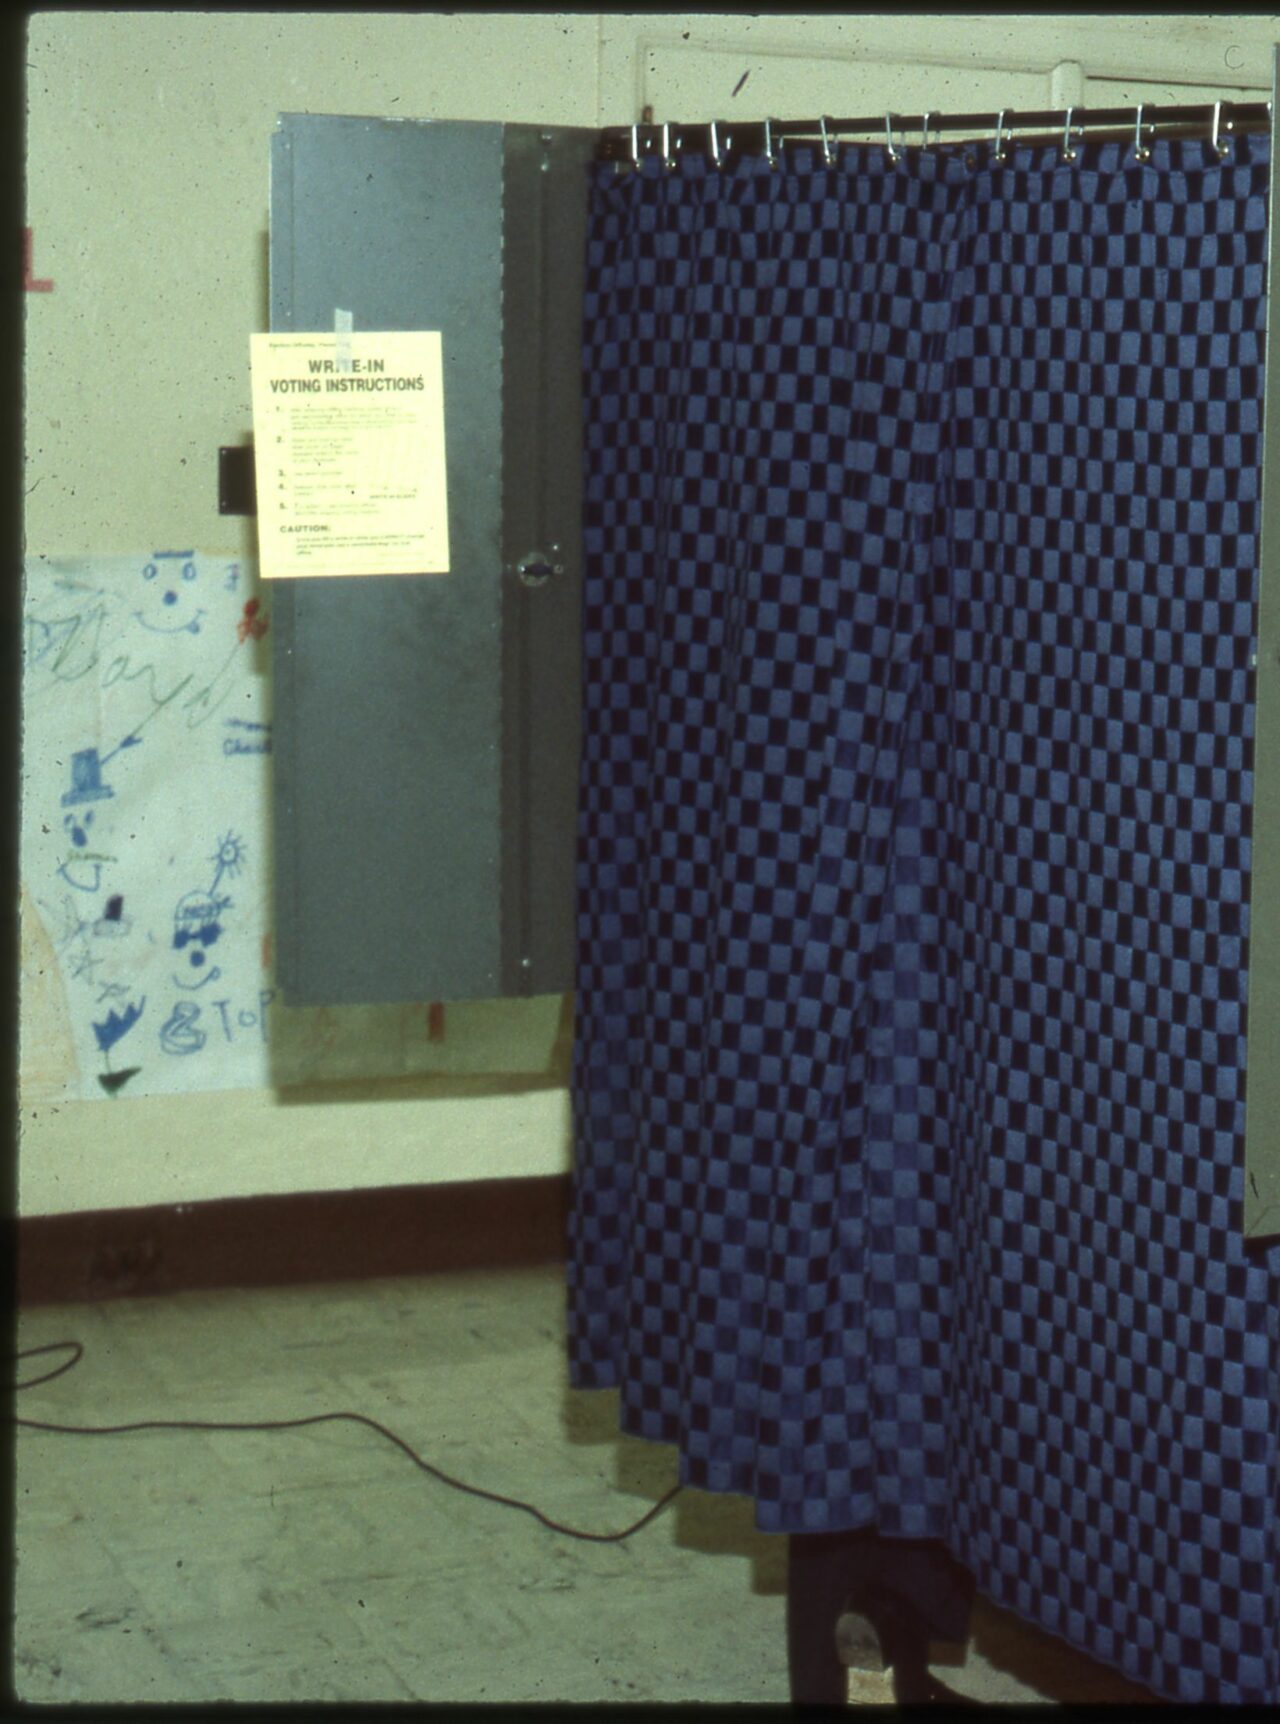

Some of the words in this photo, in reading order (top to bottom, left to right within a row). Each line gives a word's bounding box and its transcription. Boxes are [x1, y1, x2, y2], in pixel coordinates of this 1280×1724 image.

[309, 359, 385, 373] WRTE-IN
[270, 379, 321, 393] VOTING
[326, 377, 424, 392] INSTRUCTIONS
[280, 525, 331, 533] CAUTION:
